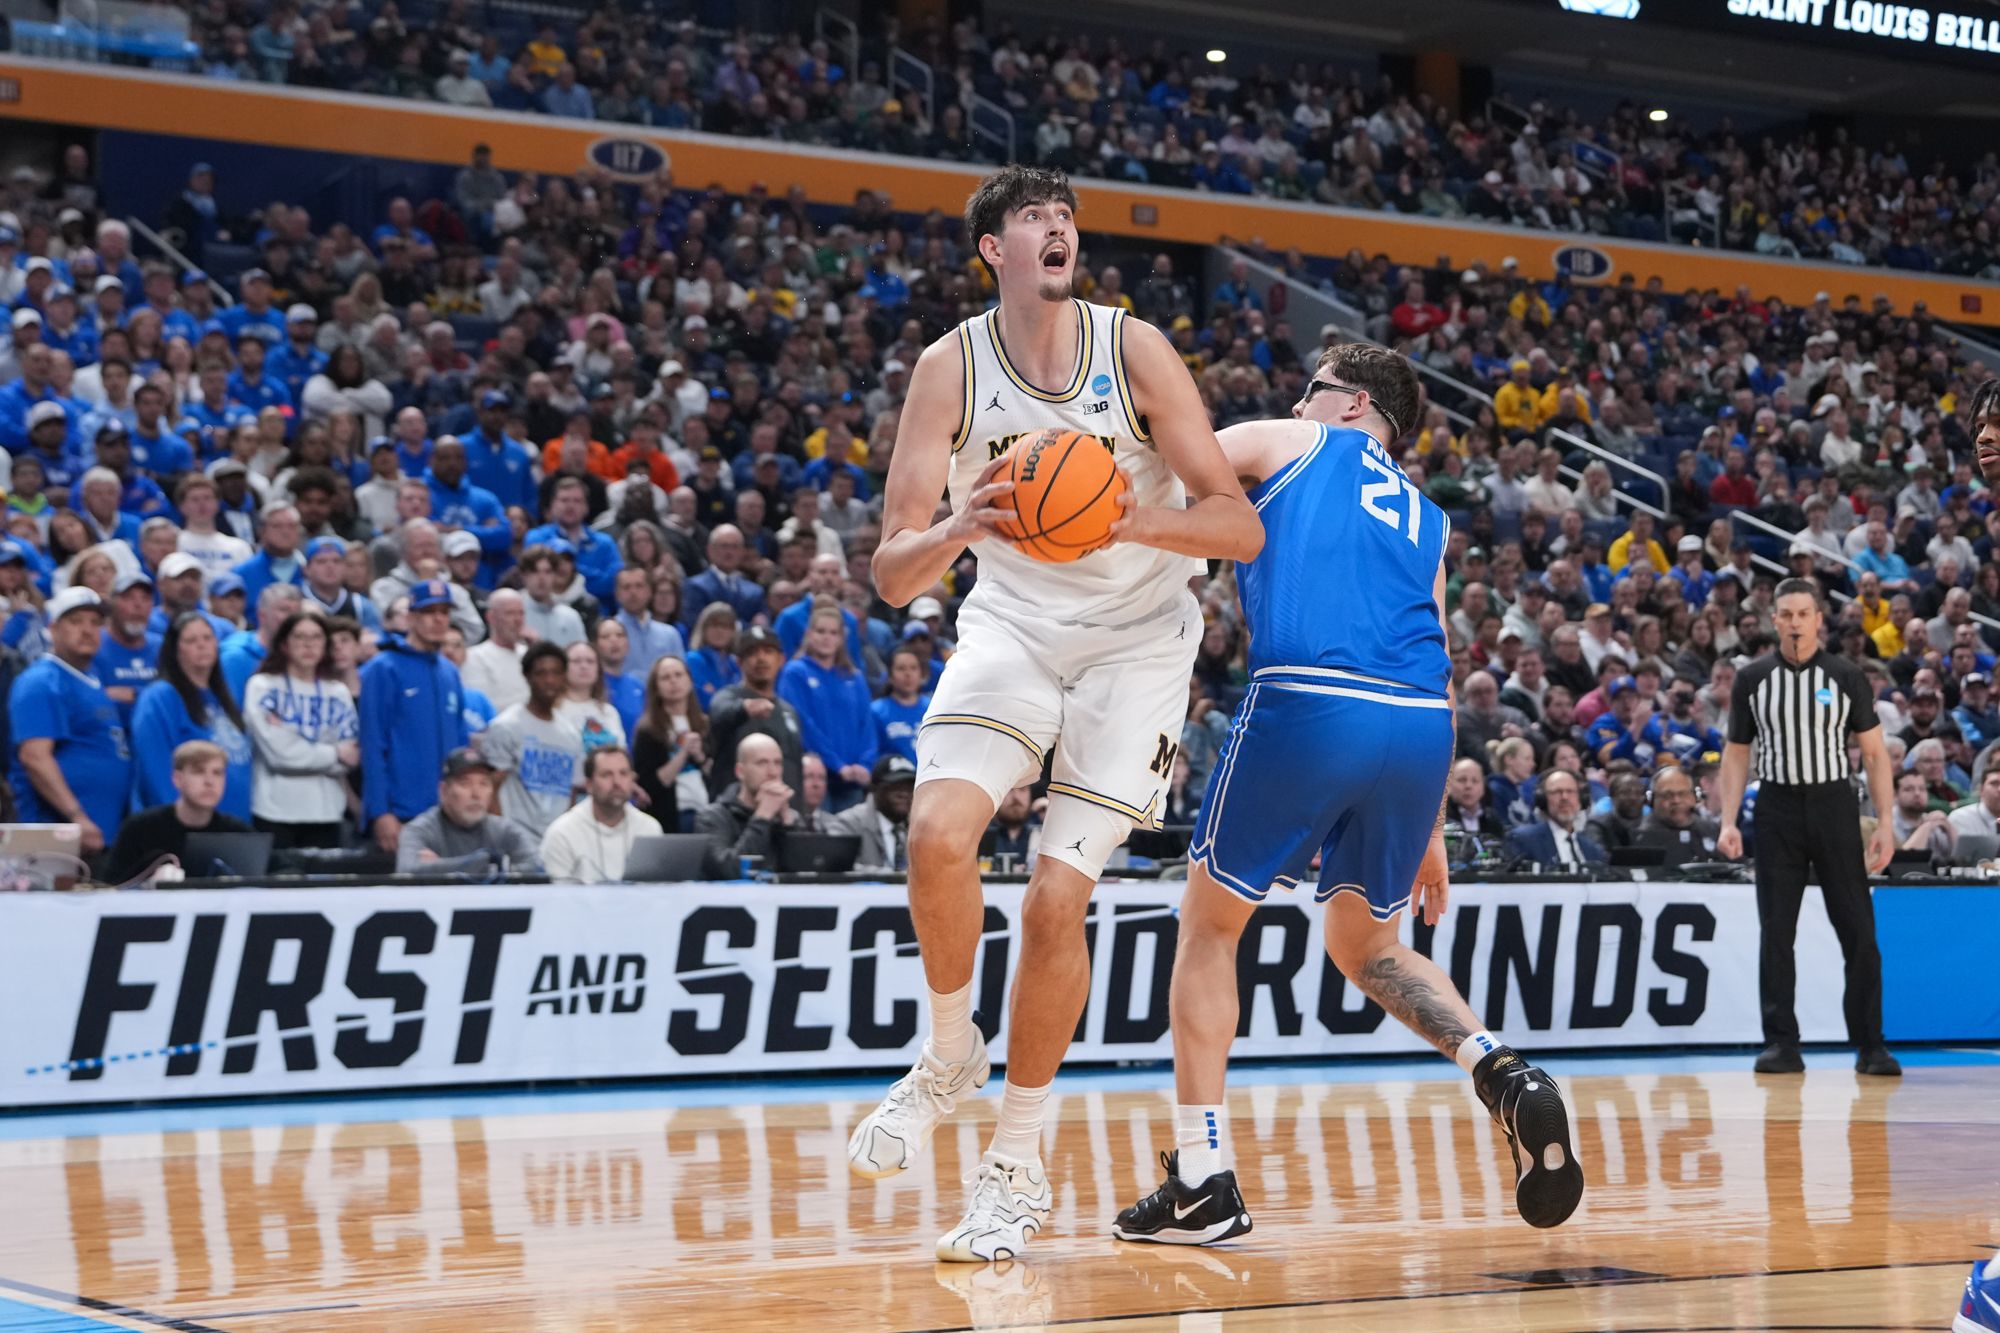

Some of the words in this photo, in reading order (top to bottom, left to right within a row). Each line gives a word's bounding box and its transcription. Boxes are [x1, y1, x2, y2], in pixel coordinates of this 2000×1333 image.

[1833, 0, 1930, 42] LOUIS
[612, 143, 645, 171] 117
[1360, 449, 1421, 549] 21
[1149, 732, 1178, 780] M
[69, 907, 532, 1081] FIRST
[526, 953, 647, 1015] AND
[667, 903, 1172, 1056] SECD
